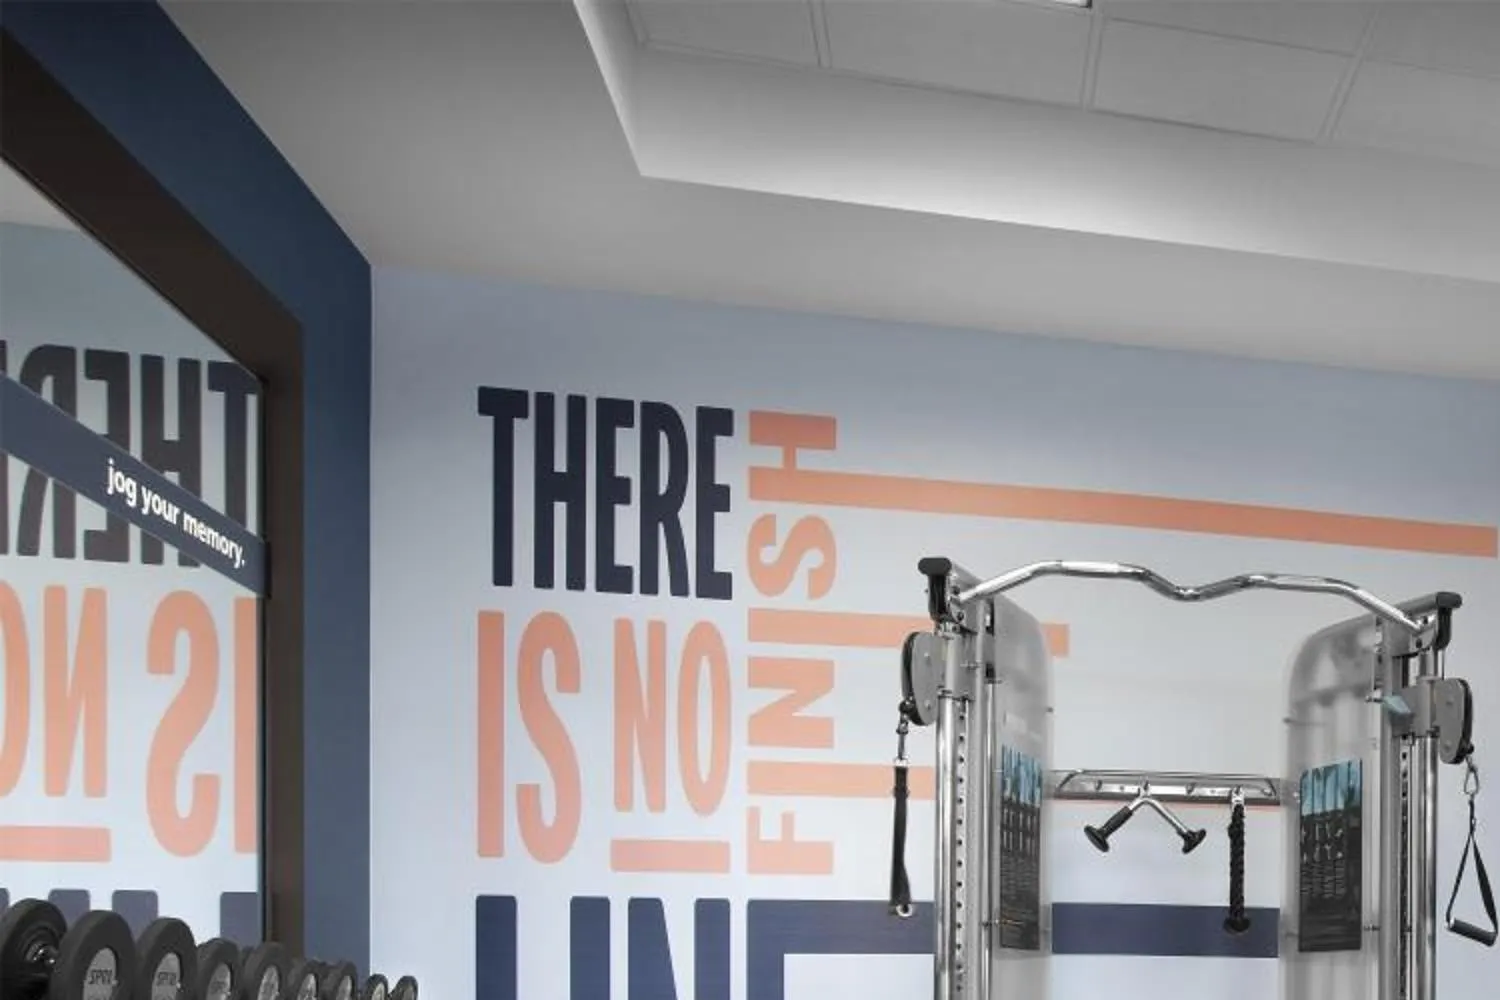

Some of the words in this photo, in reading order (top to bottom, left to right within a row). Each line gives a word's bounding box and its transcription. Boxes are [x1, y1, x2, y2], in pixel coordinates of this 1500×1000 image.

[107, 457, 137, 508] jog
[141, 486, 181, 525] your
[183, 511, 245, 569] memory.
[478, 386, 734, 600] THERE
[477, 610, 582, 864] IS
[613, 617, 732, 817] NO
